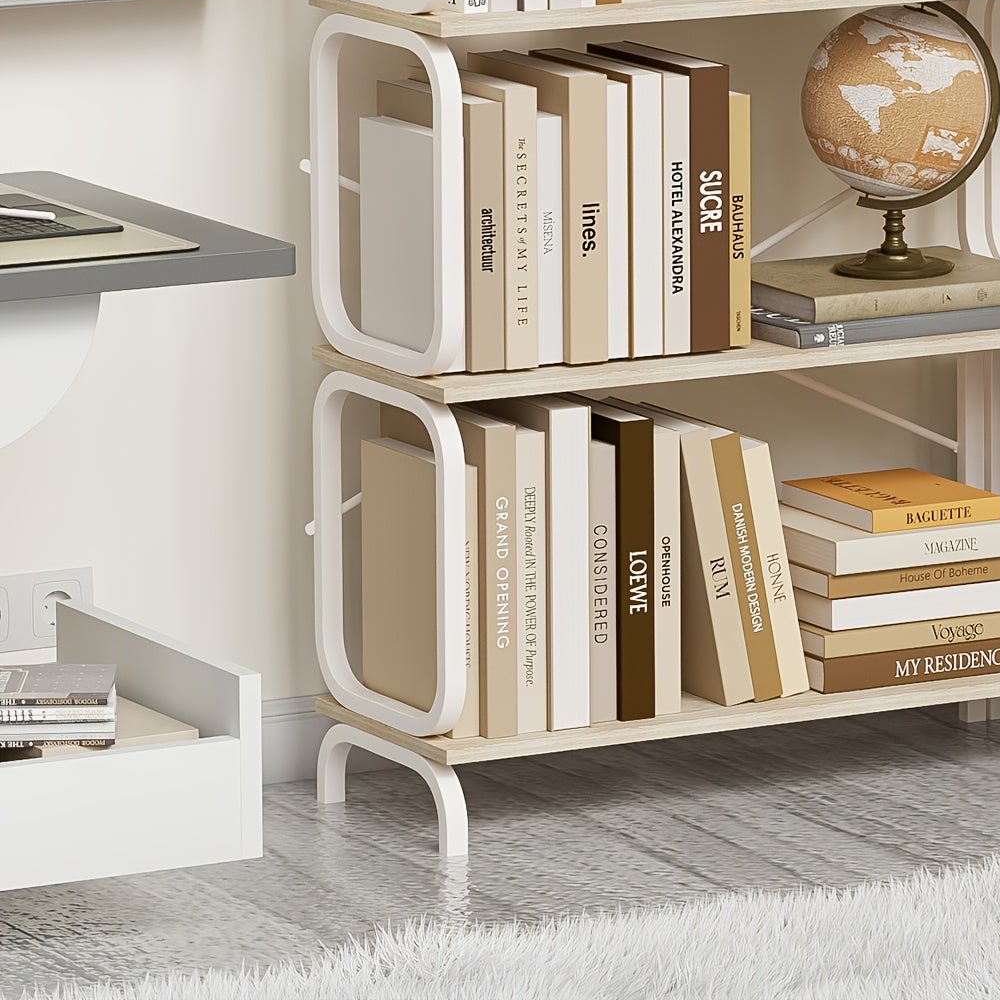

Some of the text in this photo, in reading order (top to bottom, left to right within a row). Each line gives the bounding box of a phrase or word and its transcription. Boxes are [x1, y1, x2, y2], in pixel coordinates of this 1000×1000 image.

[582, 202, 600, 258] lines.
[672, 161, 684, 294] HOTEL ALEXANDRA
[700, 170, 722, 234] SUCRE
[732, 194, 744, 260] BAUHAUS
[481, 208, 497, 273] architectuur
[906, 506, 972, 525] BAGUETTE
[924, 537, 979, 555] MAGAZINE
[496, 496, 510, 650] GRAND OPENING
[594, 525, 608, 645] CONSIDERED
[628, 550, 648, 616] LOEWE
[662, 536, 671, 608] OPENHOUSE
[710, 556, 731, 600] RUM
[732, 502, 764, 633] DANISH MODERN DESIGN
[766, 552, 786, 604] HONNE
[931, 622, 984, 642] Voyage
[894, 658, 920, 678] MY
